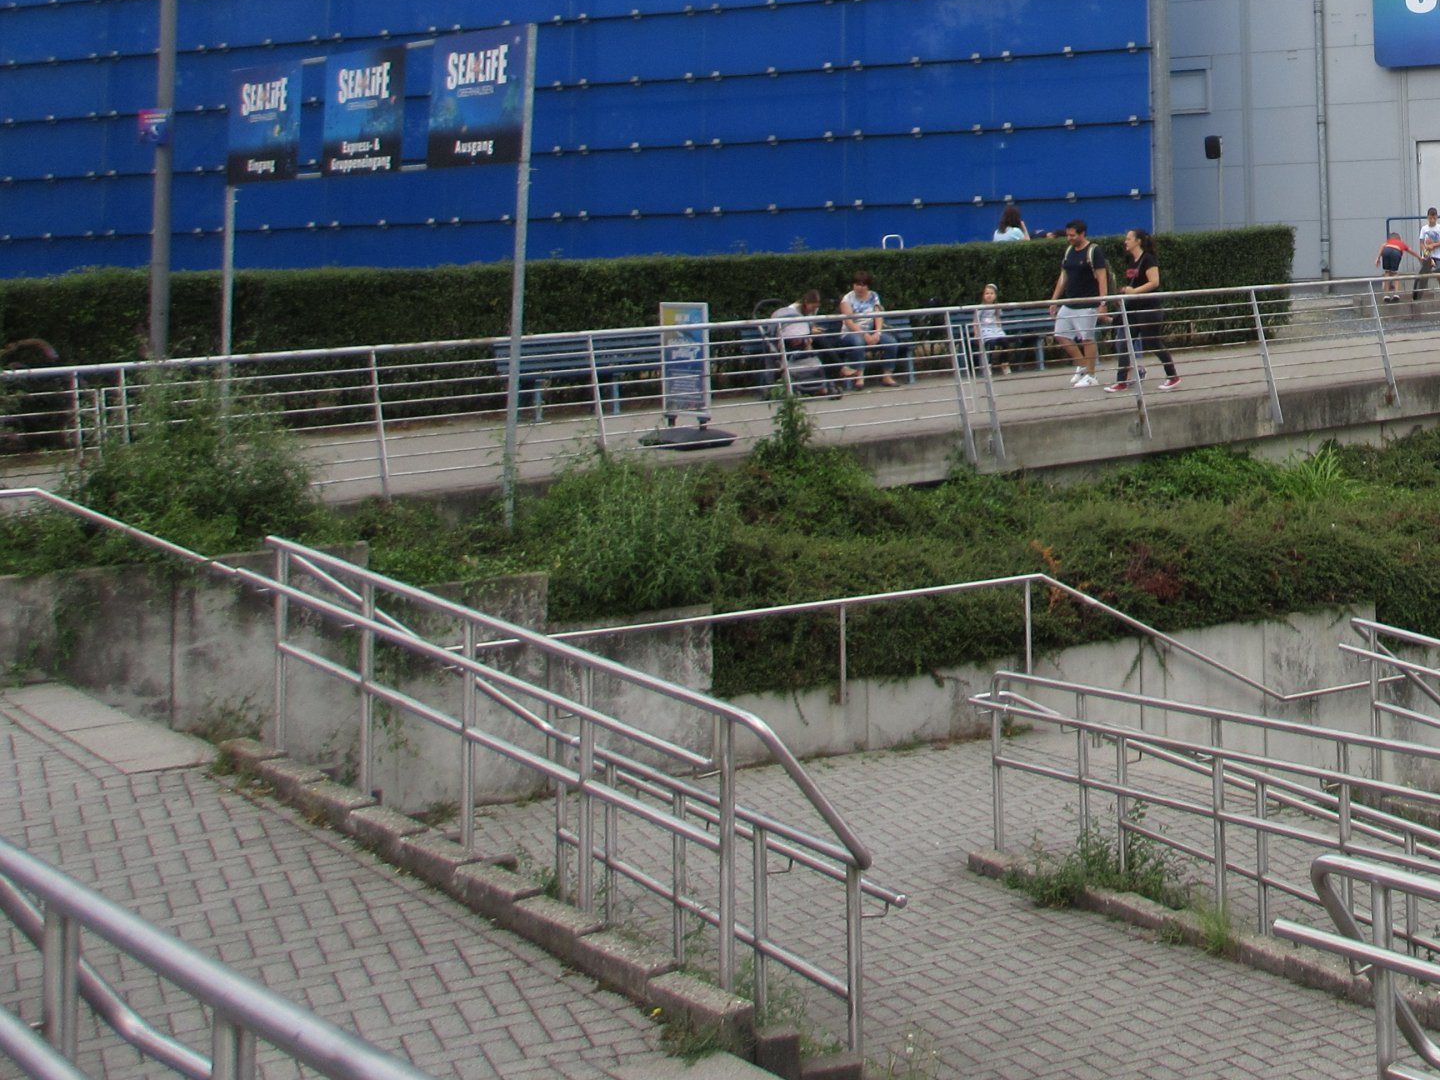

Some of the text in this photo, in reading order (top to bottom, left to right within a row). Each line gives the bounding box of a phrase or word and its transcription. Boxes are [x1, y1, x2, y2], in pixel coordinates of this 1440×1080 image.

[338, 68, 364, 104] SEA
[447, 52, 476, 90] SEA
[241, 82, 265, 117] SEA
[454, 140, 495, 157] Ausgang
[247, 159, 276, 174] Eingang
